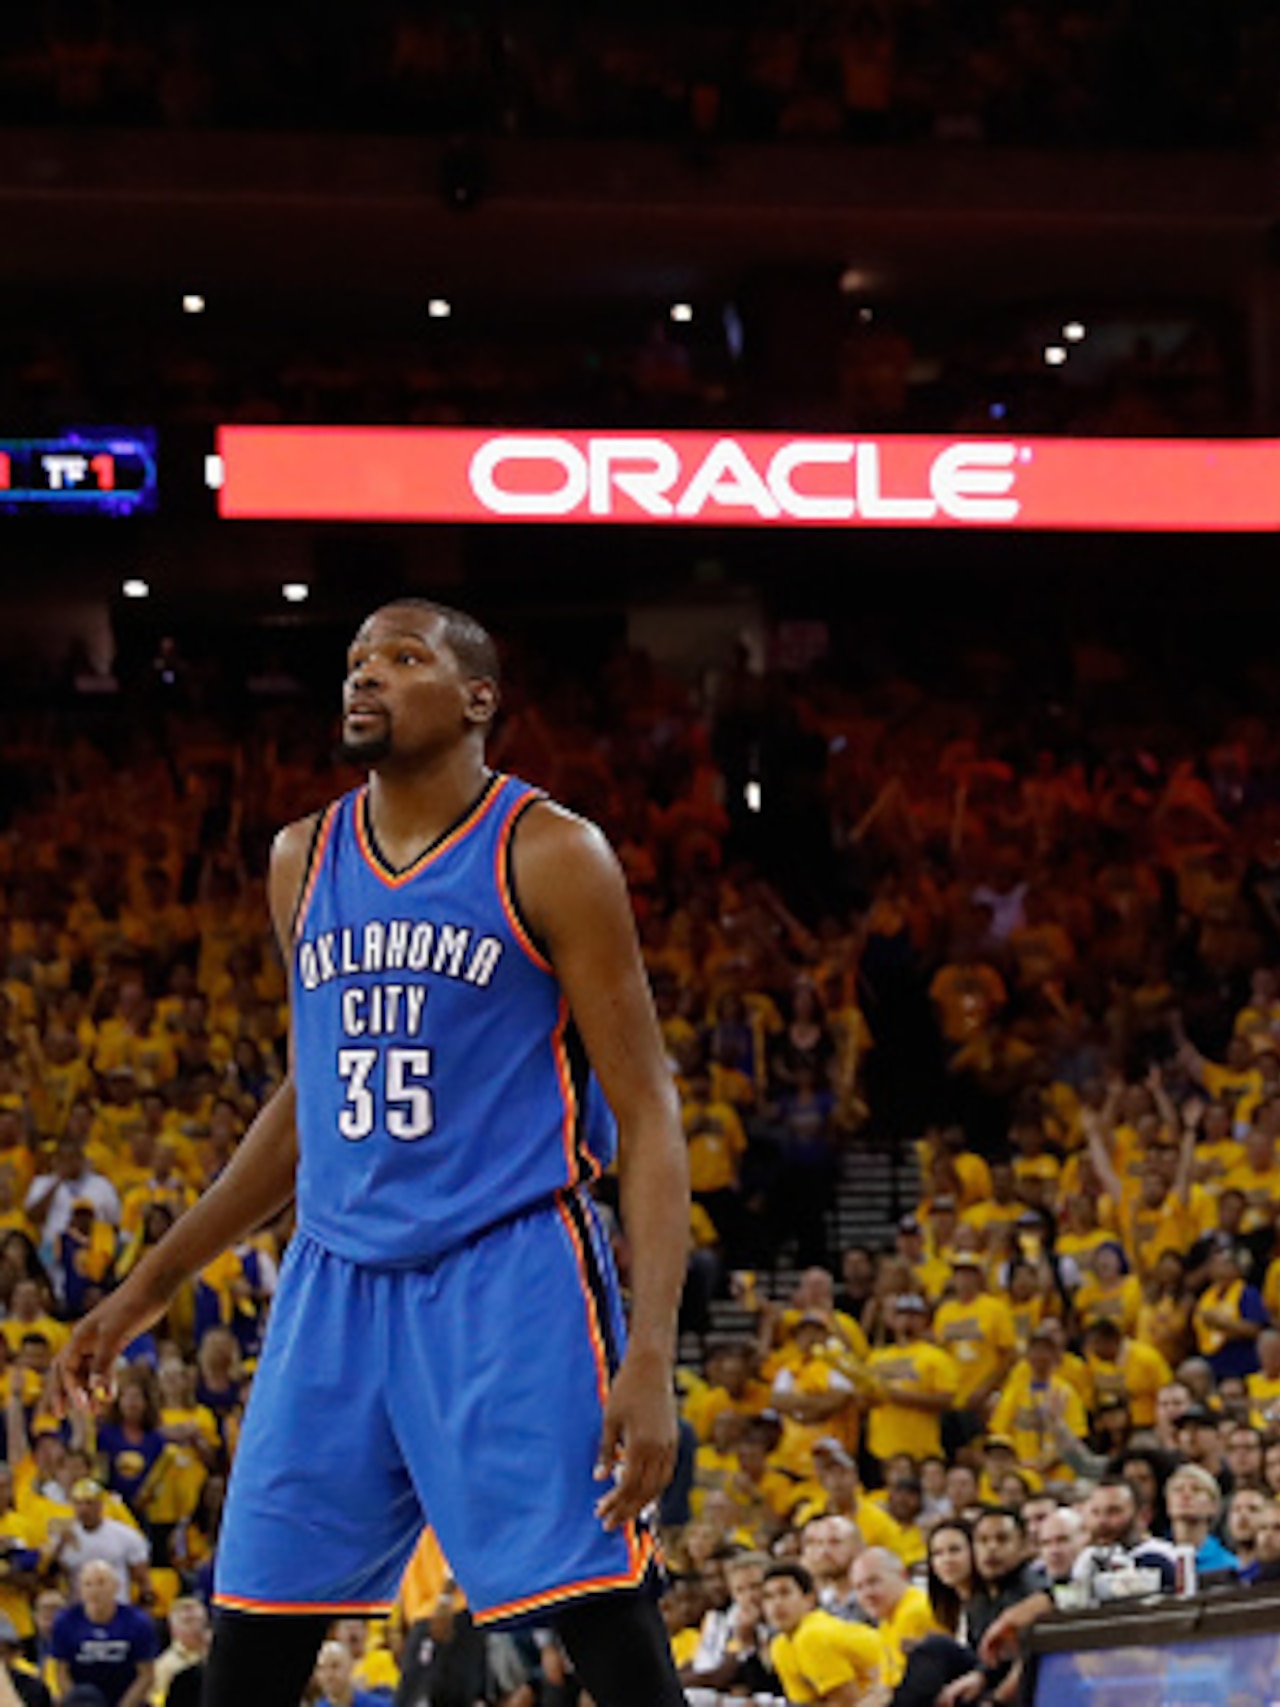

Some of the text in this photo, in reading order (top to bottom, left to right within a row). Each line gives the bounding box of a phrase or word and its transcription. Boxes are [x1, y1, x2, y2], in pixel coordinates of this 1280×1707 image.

[90, 453, 115, 491] 1
[469, 436, 1020, 521] ORACLE
[299, 919, 504, 991] OKLAHOMA
[341, 983, 427, 1038] CITY
[337, 1047, 434, 1141] 35
